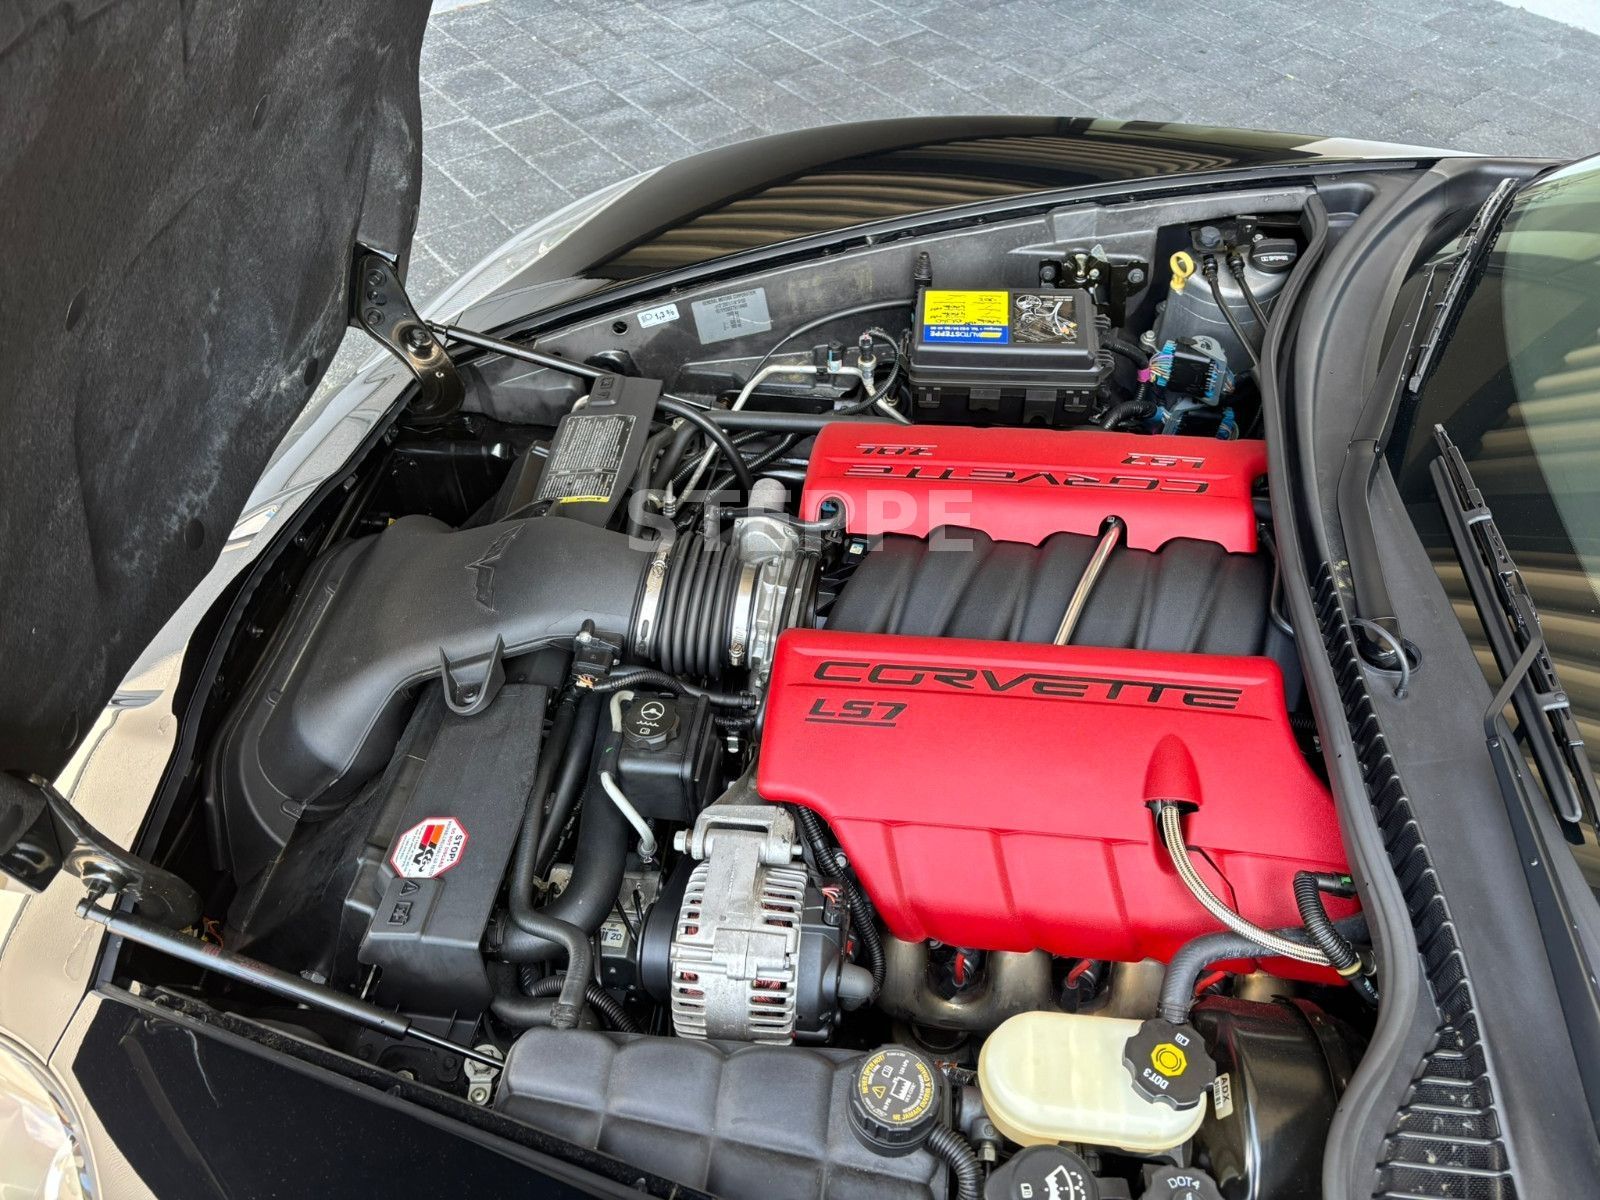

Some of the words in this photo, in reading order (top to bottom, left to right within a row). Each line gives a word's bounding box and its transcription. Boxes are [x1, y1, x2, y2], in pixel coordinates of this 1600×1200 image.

[843, 464, 1211, 495] CORVETTE
[812, 660, 1243, 710] CORVETTE
[807, 698, 908, 721] LS7
[447, 834, 463, 862] STOP!
[1221, 1077, 1230, 1103] ADX
